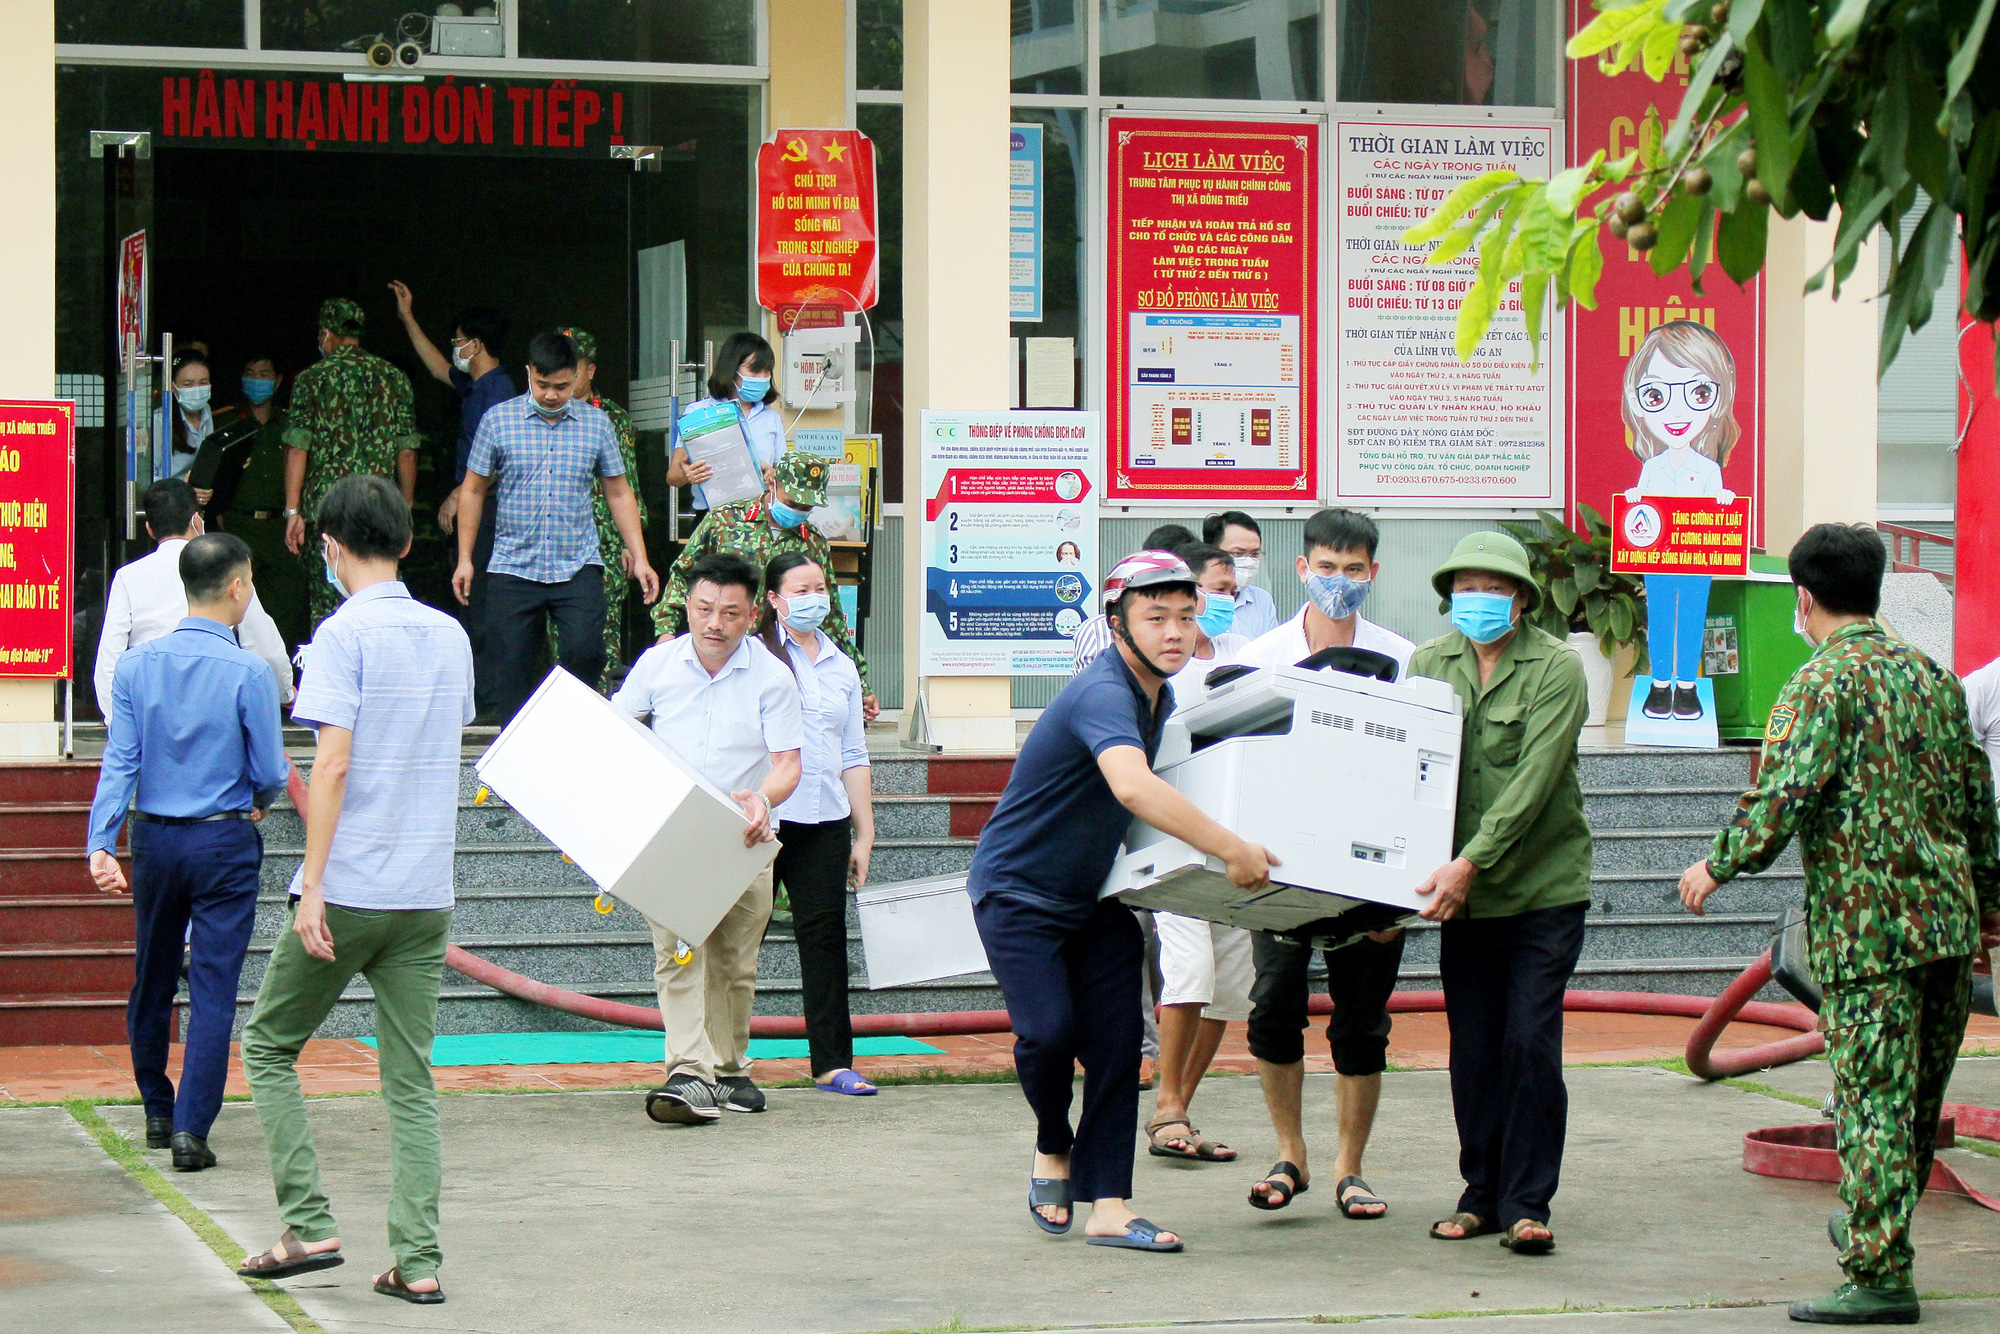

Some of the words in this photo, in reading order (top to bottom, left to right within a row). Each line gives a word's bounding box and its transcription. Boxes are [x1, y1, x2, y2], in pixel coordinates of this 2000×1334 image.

[163, 68, 256, 137] HÂN
[266, 80, 389, 150] HẠNH
[402, 74, 494, 144] ĐÓN
[508, 78, 600, 146] TIẾP
[1349, 133, 1394, 153] THỜI
[1401, 139, 1448, 154] GIAN
[1455, 136, 1495, 155] LÀM
[1501, 137, 1544, 160] VIỆC
[1144, 152, 1189, 172] LỊCH
[1194, 149, 1235, 170] LÀM
[1240, 150, 1284, 175] VIỆC
[1374, 158, 1400, 169] CÁC
[1405, 160, 1438, 170] NGÀY
[1443, 162, 1482, 171] TRONG
[795, 170, 813, 187] CHỦ
[816, 174, 836, 190] TỊCH
[1129, 178, 1156, 187] TRUNG
[1159, 177, 1176, 188] TÂM
[1179, 179, 1200, 191] PHỤC
[1203, 180, 1213, 191] VỤ
[1216, 178, 1238, 189] HÀNH
[1241, 179, 1266, 190] CHÍNH
[1269, 180, 1291, 191] CÔNG
[1172, 194, 1184, 206] THỊ
[1187, 193, 1198, 204] XÃ
[1200, 193, 1223, 204] ĐÔNG
[1377, 186, 1405, 199] SÁNG
[1416, 187, 1429, 200] TỪ
[1432, 190, 1444, 200] 07
[773, 193, 784, 209] HỒ
[787, 194, 803, 209] CHÍ
[806, 197, 830, 209] MINH
[833, 194, 841, 209] VĨ
[844, 197, 859, 213] ĐẠI
[1415, 205, 1428, 218] TỪ
[795, 214, 821, 231] SỐNG
[823, 216, 840, 231] MÃI
[1132, 217, 1154, 227] TIẾP
[1157, 219, 1186, 230] NHẬN
[1189, 219, 1202, 228] VÀ
[1206, 220, 1234, 229] HOÀN
[1237, 219, 1256, 230] TRẢ
[1277, 223, 1291, 231] SƠ
[1129, 232, 1150, 240] CHO
[1169, 231, 1196, 241] CHỨC
[1200, 232, 1213, 241] VÀ
[1216, 232, 1236, 242] CÁC
[1240, 233, 1268, 242] CÔNG
[1272, 234, 1292, 243] DÂN
[1346, 236, 1370, 250] THỜI
[1374, 240, 1399, 250] GIAN
[777, 241, 807, 254] TRONG
[810, 241, 824, 257] SỰ
[825, 238, 859, 257] NGHIỆP
[1174, 244, 1193, 253] VÀO
[1197, 244, 1217, 254] CÁC
[1221, 245, 1248, 254] NGÀY
[1154, 256, 1175, 265] LÀM
[1179, 256, 1201, 268] VIỆC
[1205, 258, 1238, 266] TRONG
[1372, 253, 1398, 264] CÁC
[782, 259, 802, 276] CỦA
[803, 260, 835, 276] CHÚNG
[838, 263, 851, 276] TA!
[1161, 268, 1174, 277] TỪ
[1177, 268, 1197, 278] THỨ
[1208, 268, 1229, 278] ĐẾN
[1232, 270, 1252, 279] THỨ
[1377, 278, 1405, 291] SÁNG
[1416, 278, 1430, 291] TỪ
[1432, 281, 1444, 291] 08
[1449, 279, 1466, 292] GIỜ
[1138, 289, 1155, 308] SƠ
[1157, 283, 1174, 308] ĐỒ
[1177, 287, 1218, 309] PHÒNG
[1221, 288, 1248, 309] LÀM
[1251, 288, 1279, 313] VIỆC
[1415, 296, 1429, 309] TỪ
[1432, 299, 1444, 309] 13
[1346, 327, 1367, 338] THỜI
[1370, 330, 1393, 338] GIAN
[1396, 328, 1417, 339] TIẾP
[1420, 329, 1446, 341] NHẬN
[1505, 330, 1522, 340] CÁC
[801, 360, 814, 374] HÒM
[7, 420, 16, 434] XÃ
[17, 420, 35, 434] ĐÔNG
[969, 423, 988, 437] THÔNG
[989, 423, 1002, 440] ĐIỆP
[1013, 423, 1032, 438] PHÒNG
[1035, 422, 1054, 438] CHỐNG
[1056, 426, 1069, 441] DỊCH
[1377, 475, 1516, 484] ĐT:02033.670.675-0233.670.600
[24, 498, 47, 533] HIỆN
[950, 512, 958, 530] 2
[1672, 510, 1689, 525] TĂNG
[1691, 510, 1714, 525] CƯỜNG
[1715, 508, 1724, 525] KỶ
[1726, 511, 1742, 528] LUẬT
[1671, 527, 1679, 544] KỶ
[1703, 530, 1721, 545] HÀNH
[1722, 531, 1742, 545] CHÍNH
[1617, 549, 1630, 563] XÂY
[1630, 550, 1646, 565] DỰNG
[1648, 548, 1660, 563] NẾP
[1661, 547, 1678, 564] SỐNG
[1679, 550, 1693, 564] VĂN
[1693, 550, 1708, 566] HÓA,
[1709, 551, 1722, 565] VĂN
[1724, 553, 1741, 565] MINH
[16, 579, 36, 609] BÁO
[48, 576, 60, 609] TẾ
[950, 579, 958, 598] 4
